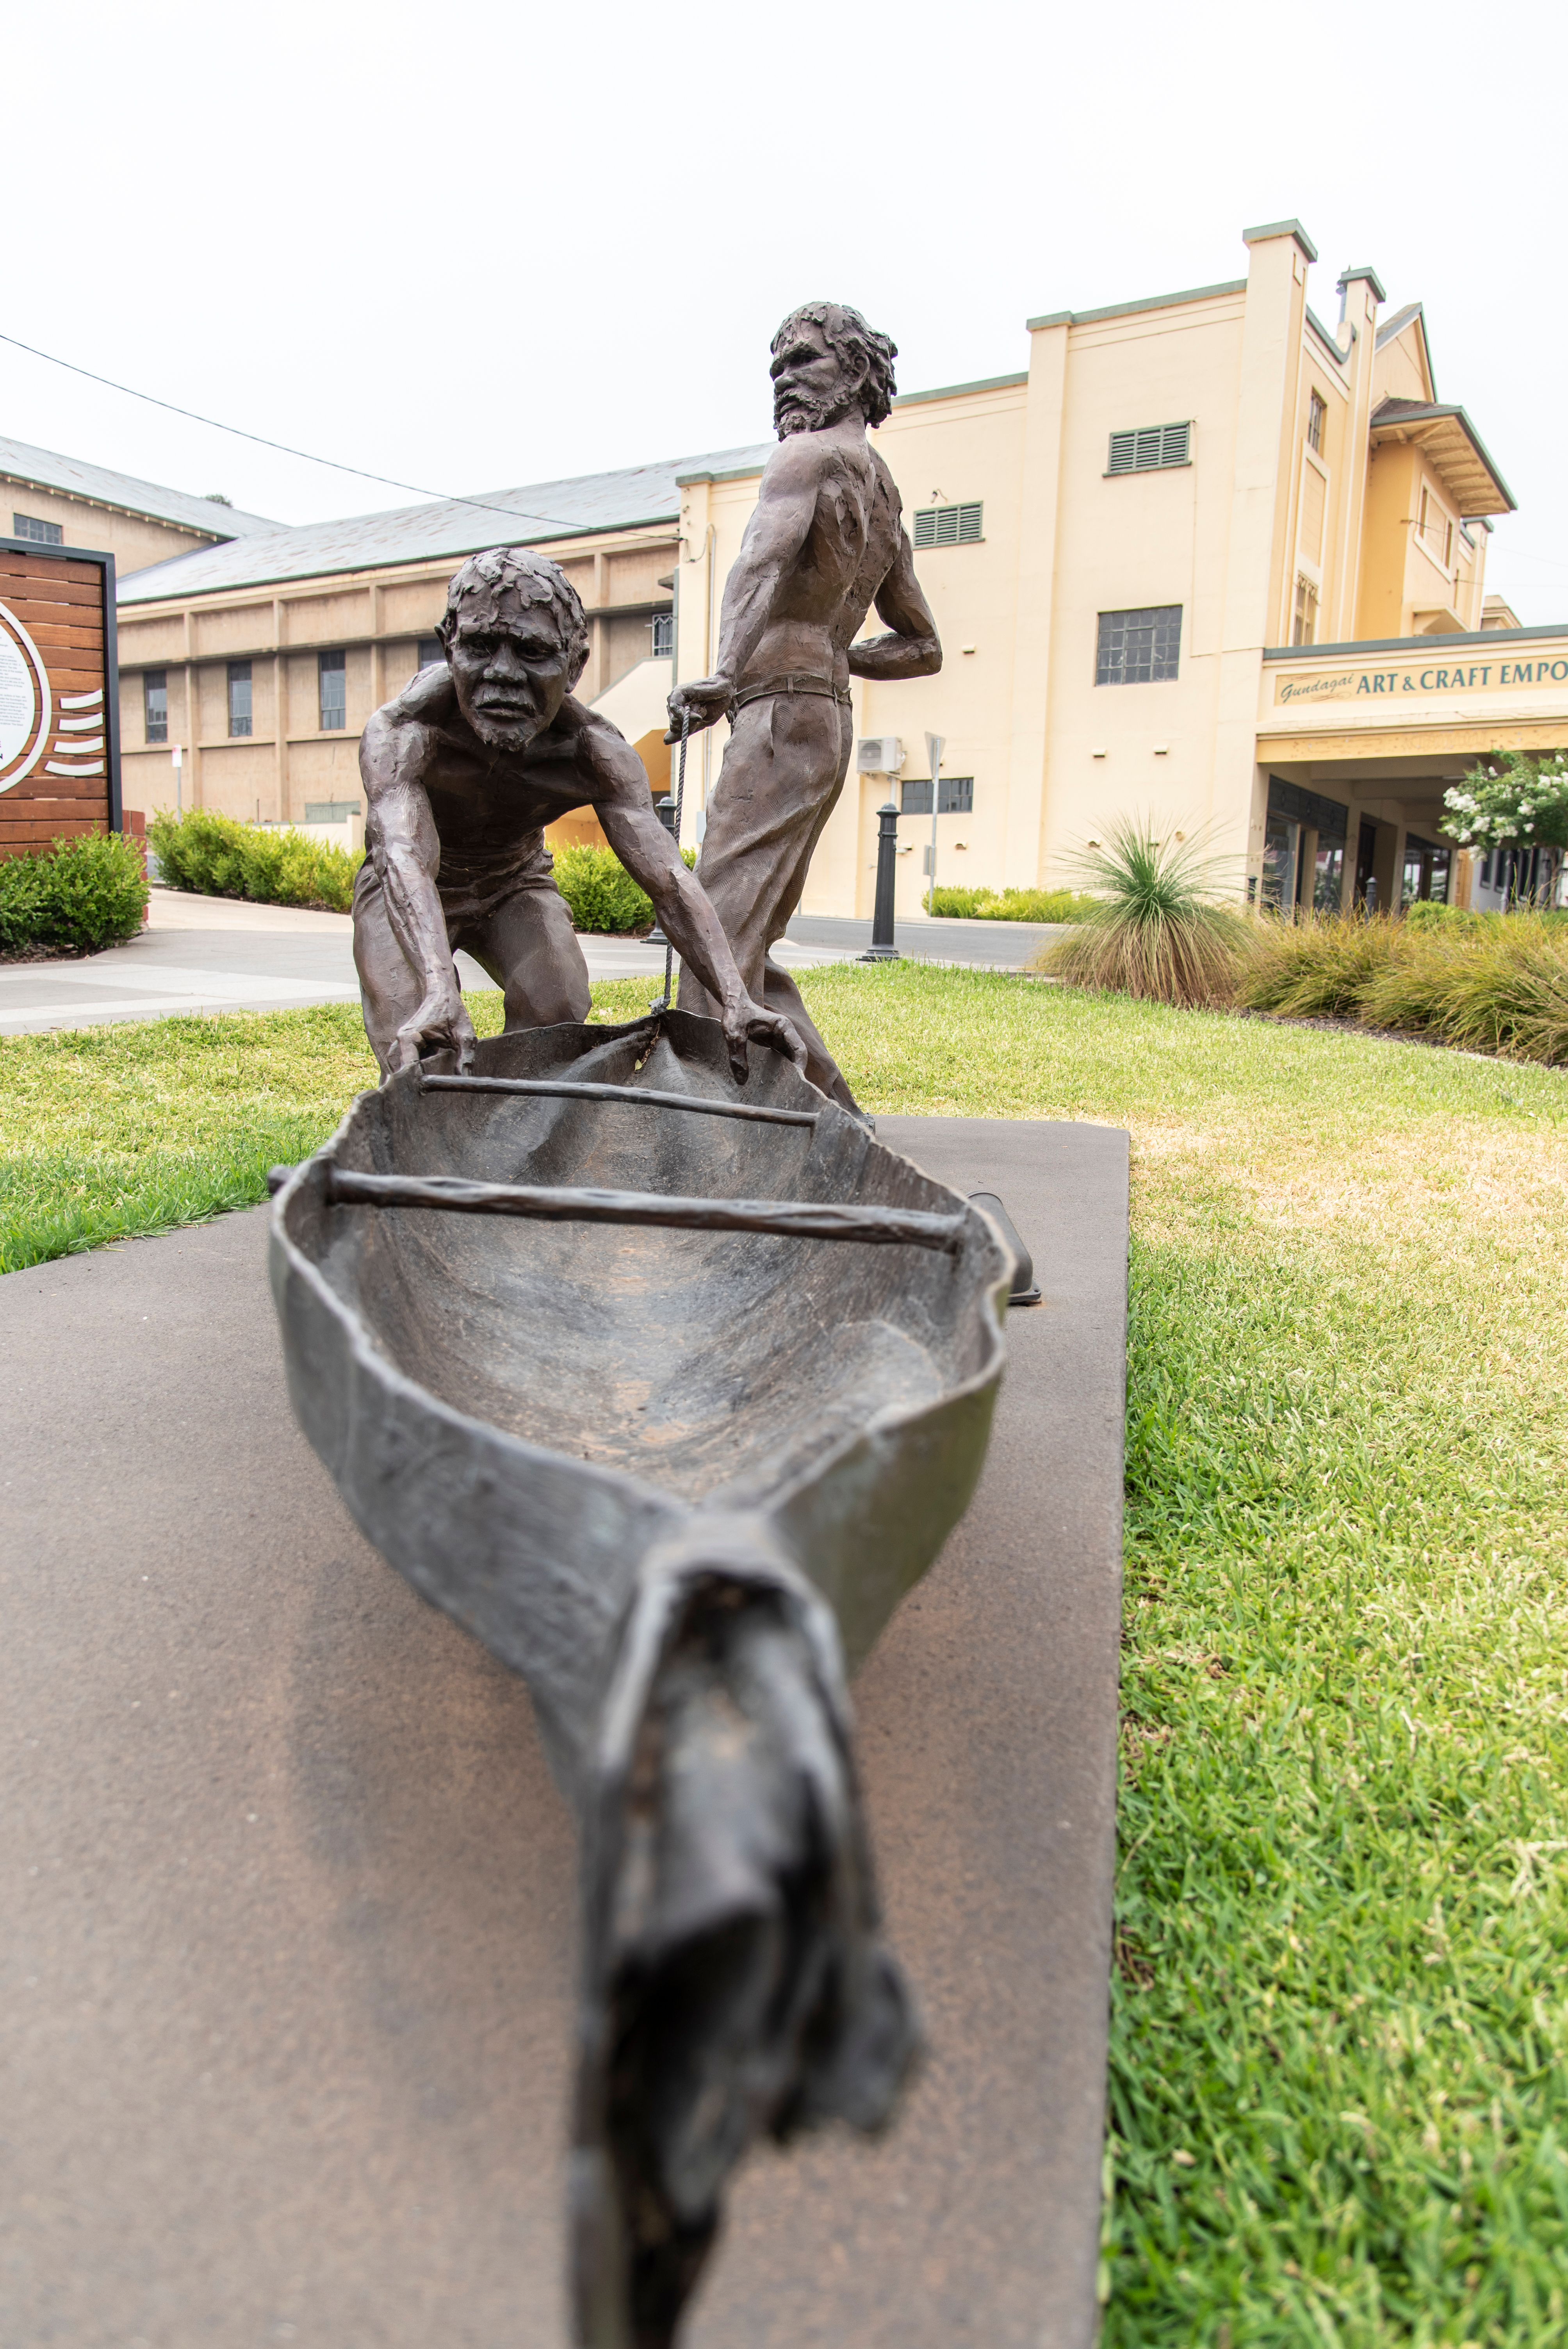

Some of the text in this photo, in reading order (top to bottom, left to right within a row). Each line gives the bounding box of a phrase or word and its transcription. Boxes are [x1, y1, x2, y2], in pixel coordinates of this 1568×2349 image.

[1281, 673, 1354, 704] Gundagai
[1356, 673, 1399, 694] ART
[1402, 676, 1416, 691] &
[1420, 666, 1492, 690] CRAFT
